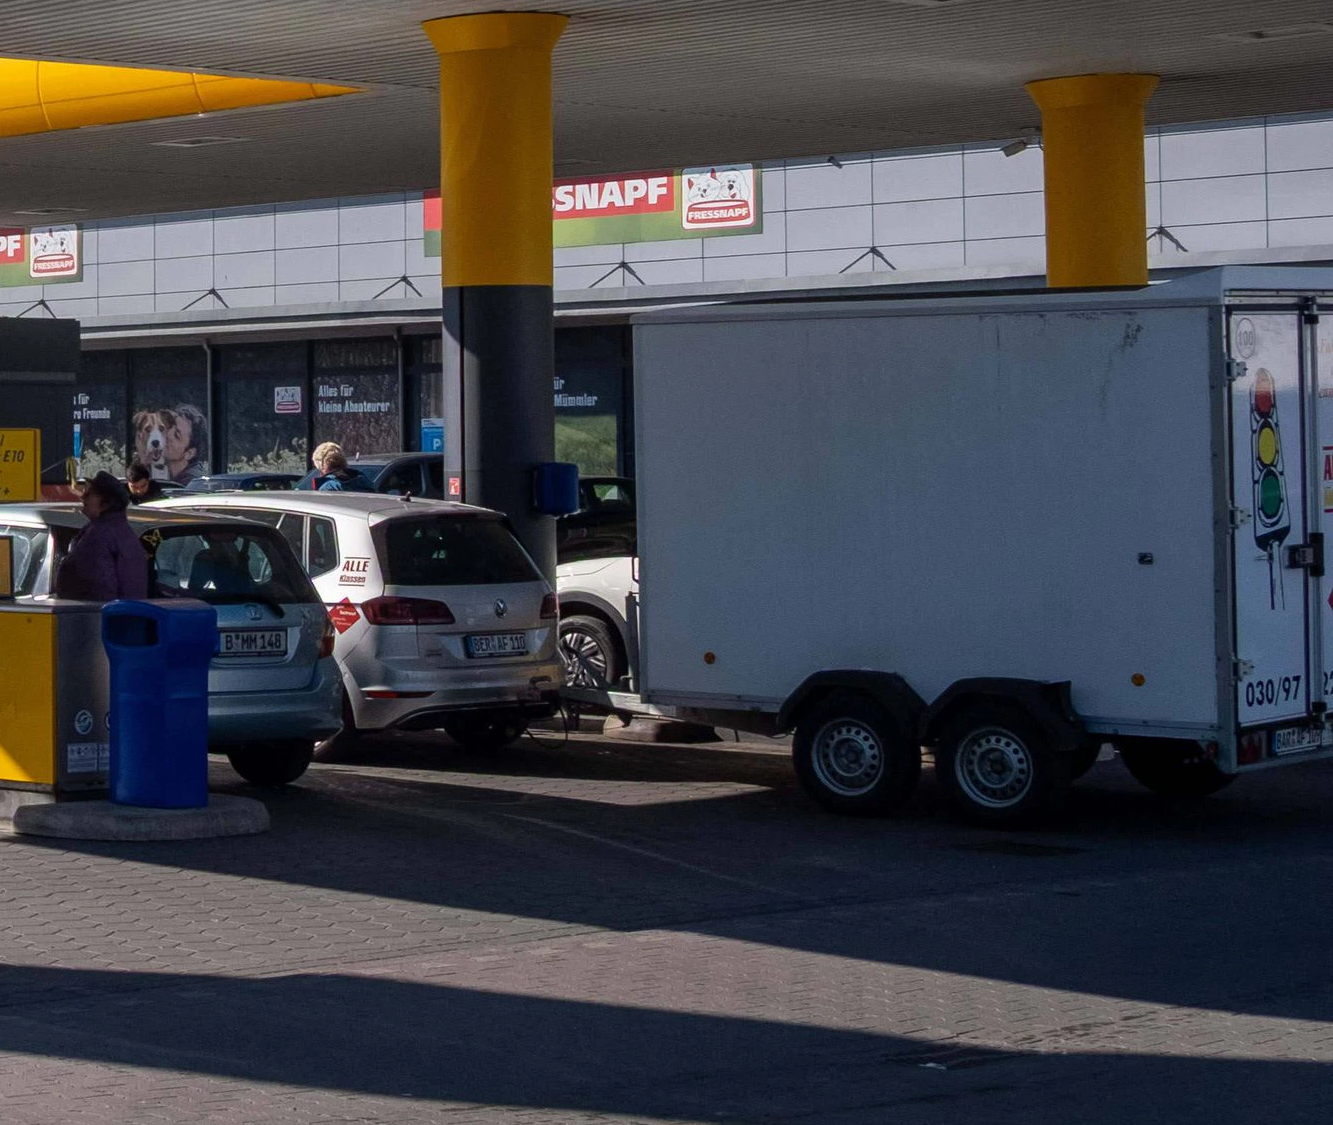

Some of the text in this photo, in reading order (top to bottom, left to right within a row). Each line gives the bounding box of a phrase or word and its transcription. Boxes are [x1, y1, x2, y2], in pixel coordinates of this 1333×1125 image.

[688, 206, 749, 221] FRESSNAPF
[33, 259, 74, 271] FRESSNAPF
[1238, 330, 1254, 347] 100
[318, 384, 354, 397] Alles für
[78, 393, 90, 405] für
[554, 393, 598, 407] Mümmler
[318, 400, 390, 413] kleine Abenteurer
[3, 450, 25, 463] E10
[341, 560, 370, 572] ALLE
[339, 575, 366, 583] Klassen
[225, 633, 282, 650] B MM 148
